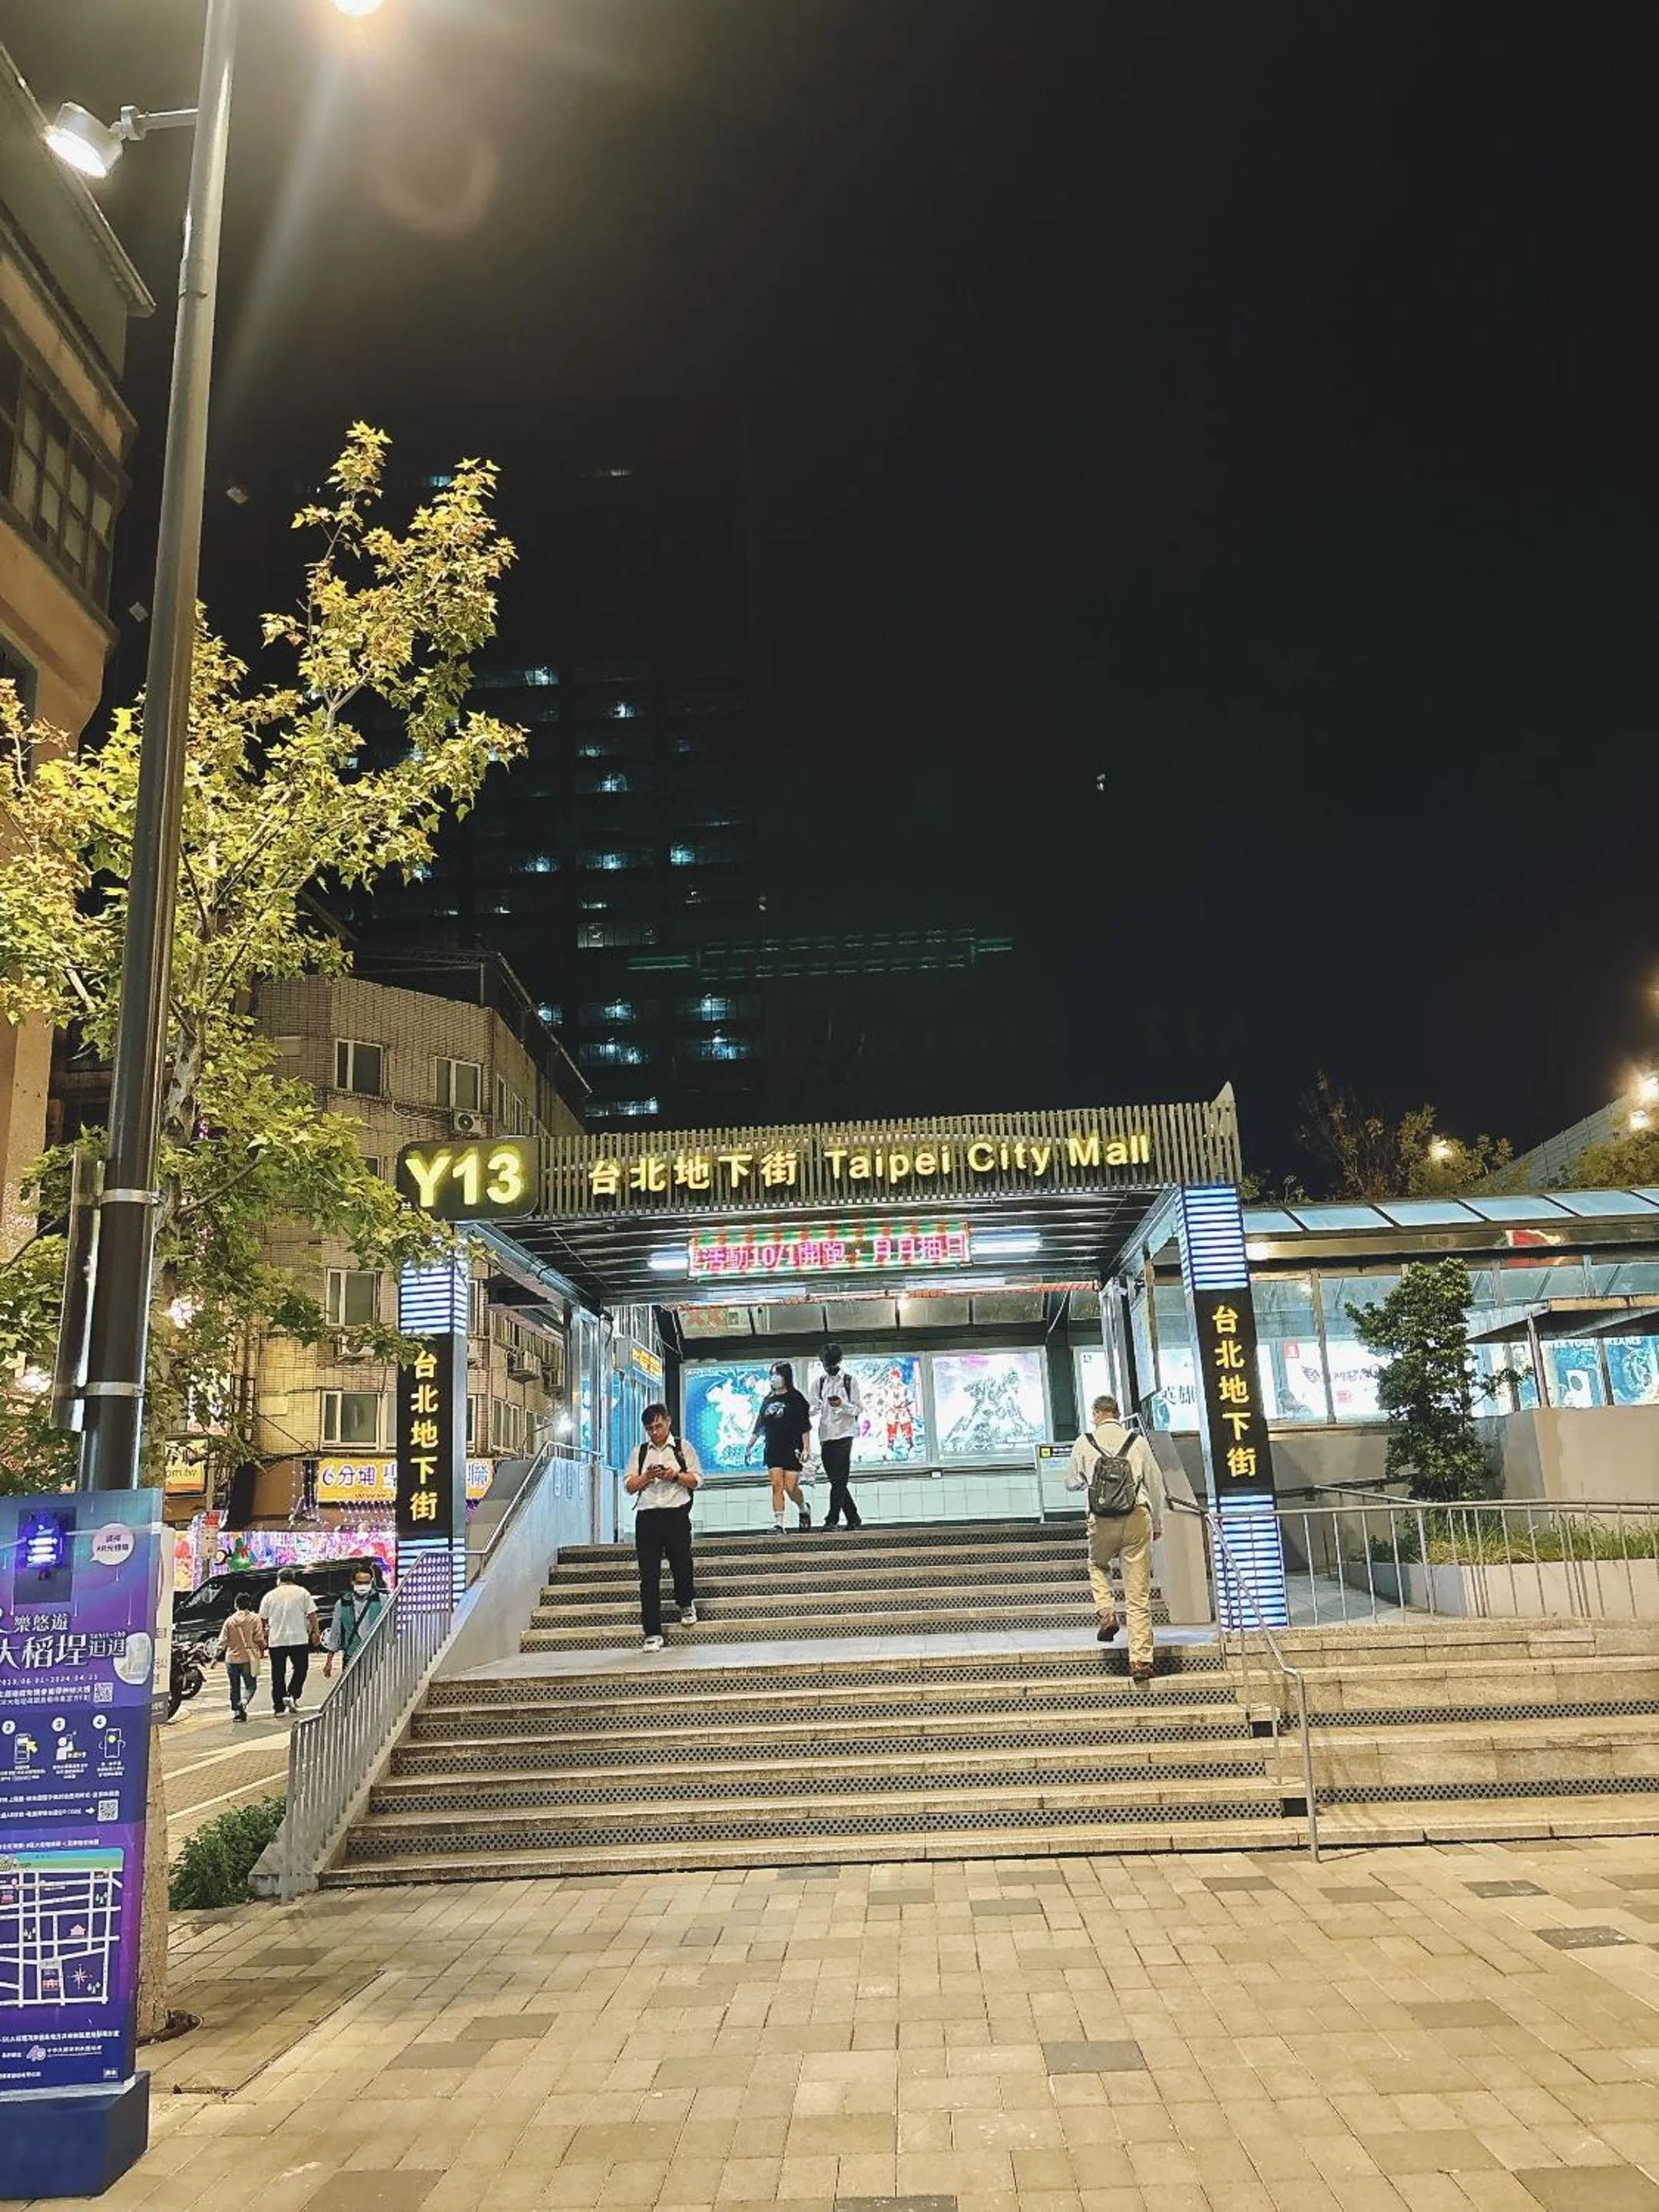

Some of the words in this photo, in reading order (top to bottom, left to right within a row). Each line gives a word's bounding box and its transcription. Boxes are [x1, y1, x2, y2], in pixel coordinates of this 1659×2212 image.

[405, 1151, 522, 1207] Y13
[588, 1151, 797, 1195] 台北地下街
[826, 1146, 951, 1184] Taipei
[968, 1141, 1051, 1176] City
[1068, 1134, 1150, 1167] Mall
[409, 1350, 439, 1521] 台北地下街
[1212, 1305, 1257, 1478] 台北地下街
